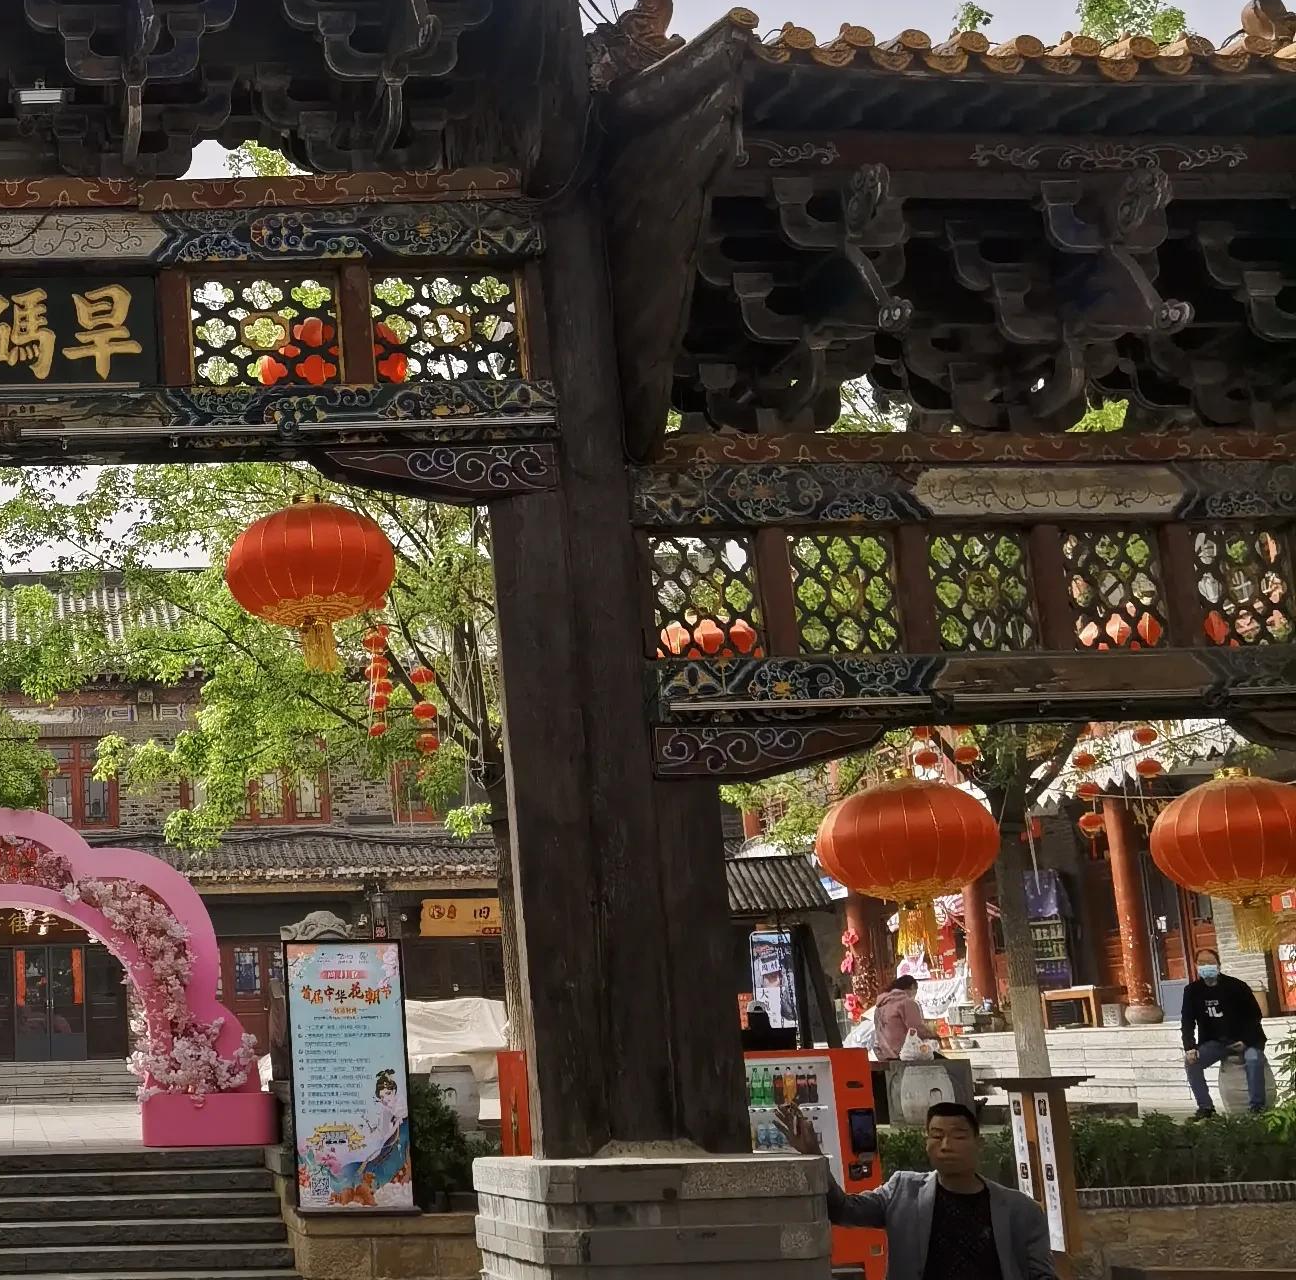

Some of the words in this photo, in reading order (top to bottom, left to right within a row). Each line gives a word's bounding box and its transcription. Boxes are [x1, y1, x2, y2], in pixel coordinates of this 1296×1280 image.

[300, 981, 393, 1005] 首届中华花朝节
